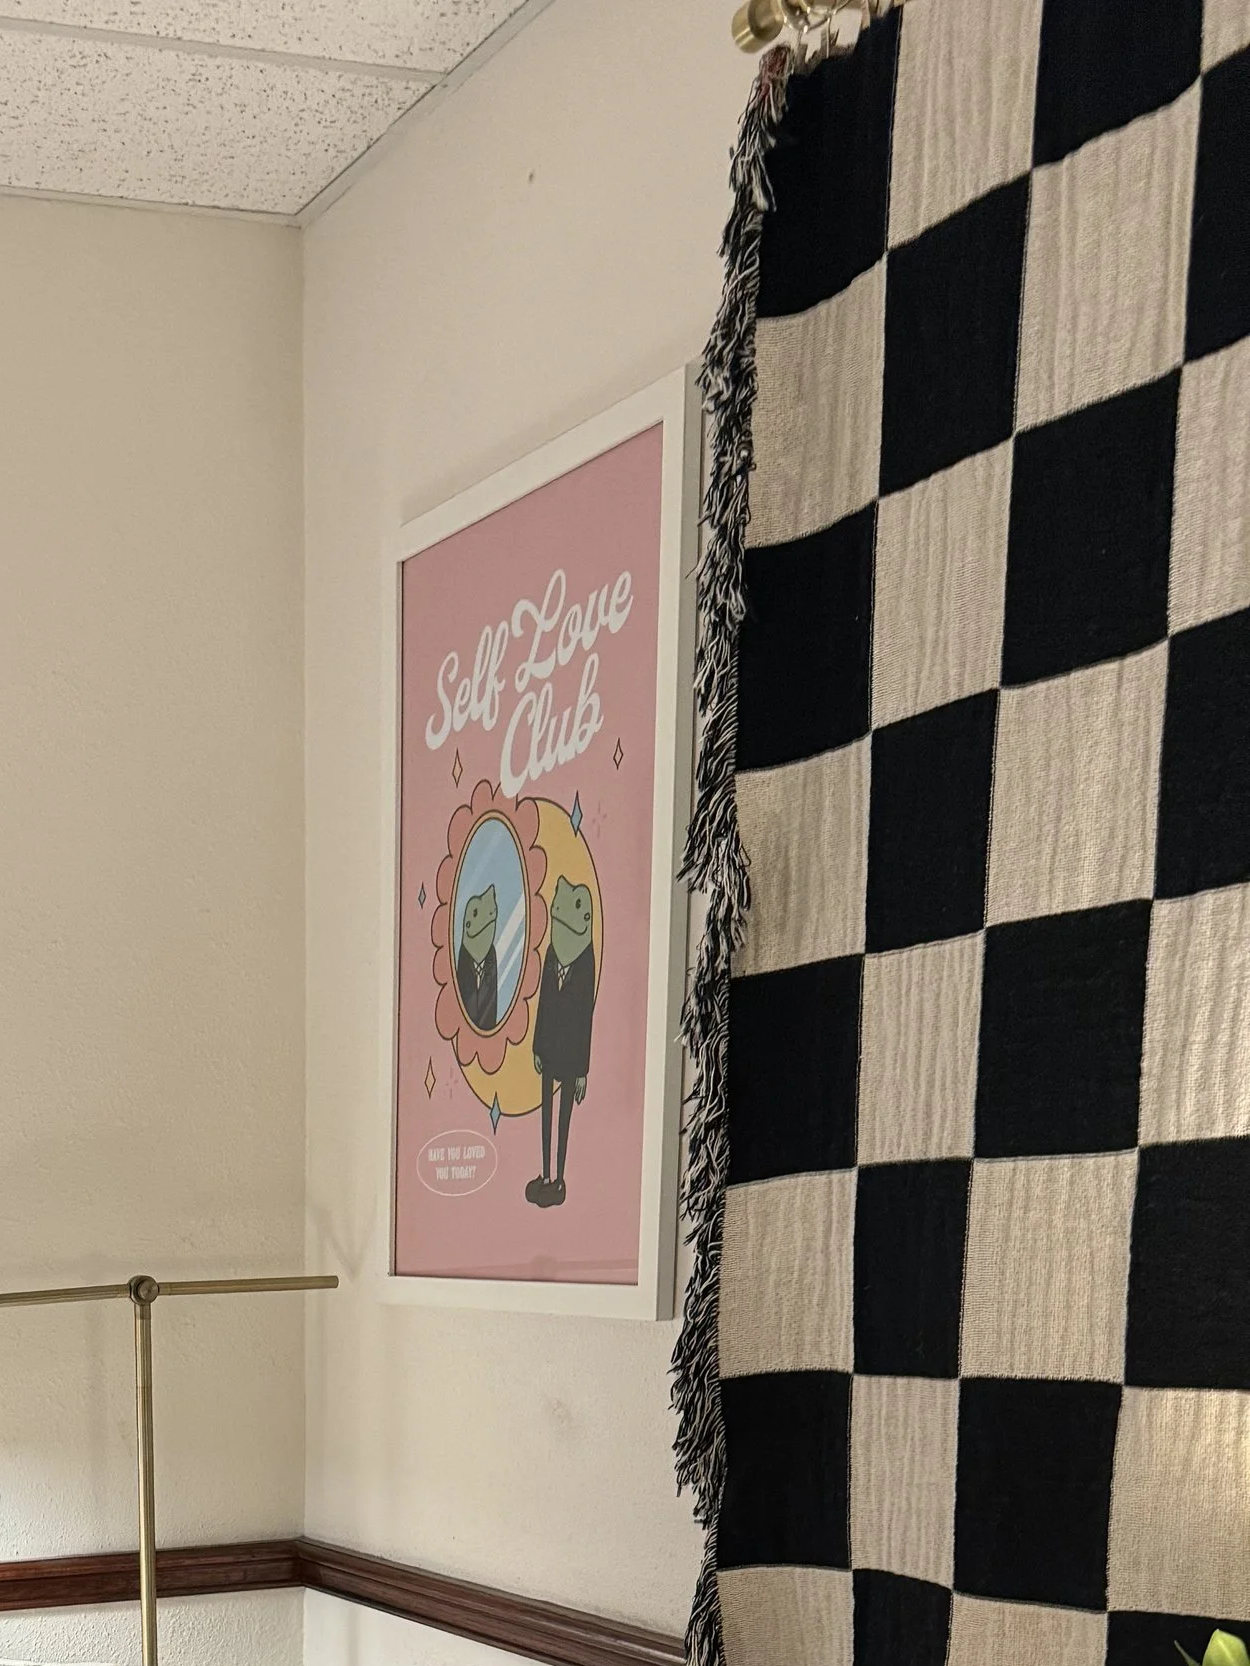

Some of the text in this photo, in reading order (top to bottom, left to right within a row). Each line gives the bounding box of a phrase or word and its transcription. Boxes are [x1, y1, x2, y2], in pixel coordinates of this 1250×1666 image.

[425, 569, 633, 750] Self Love
[500, 652, 604, 798] Club
[435, 1166, 448, 1180] YOU
[448, 1146, 461, 1160] YOU
[463, 1145, 485, 1159] LOVED
